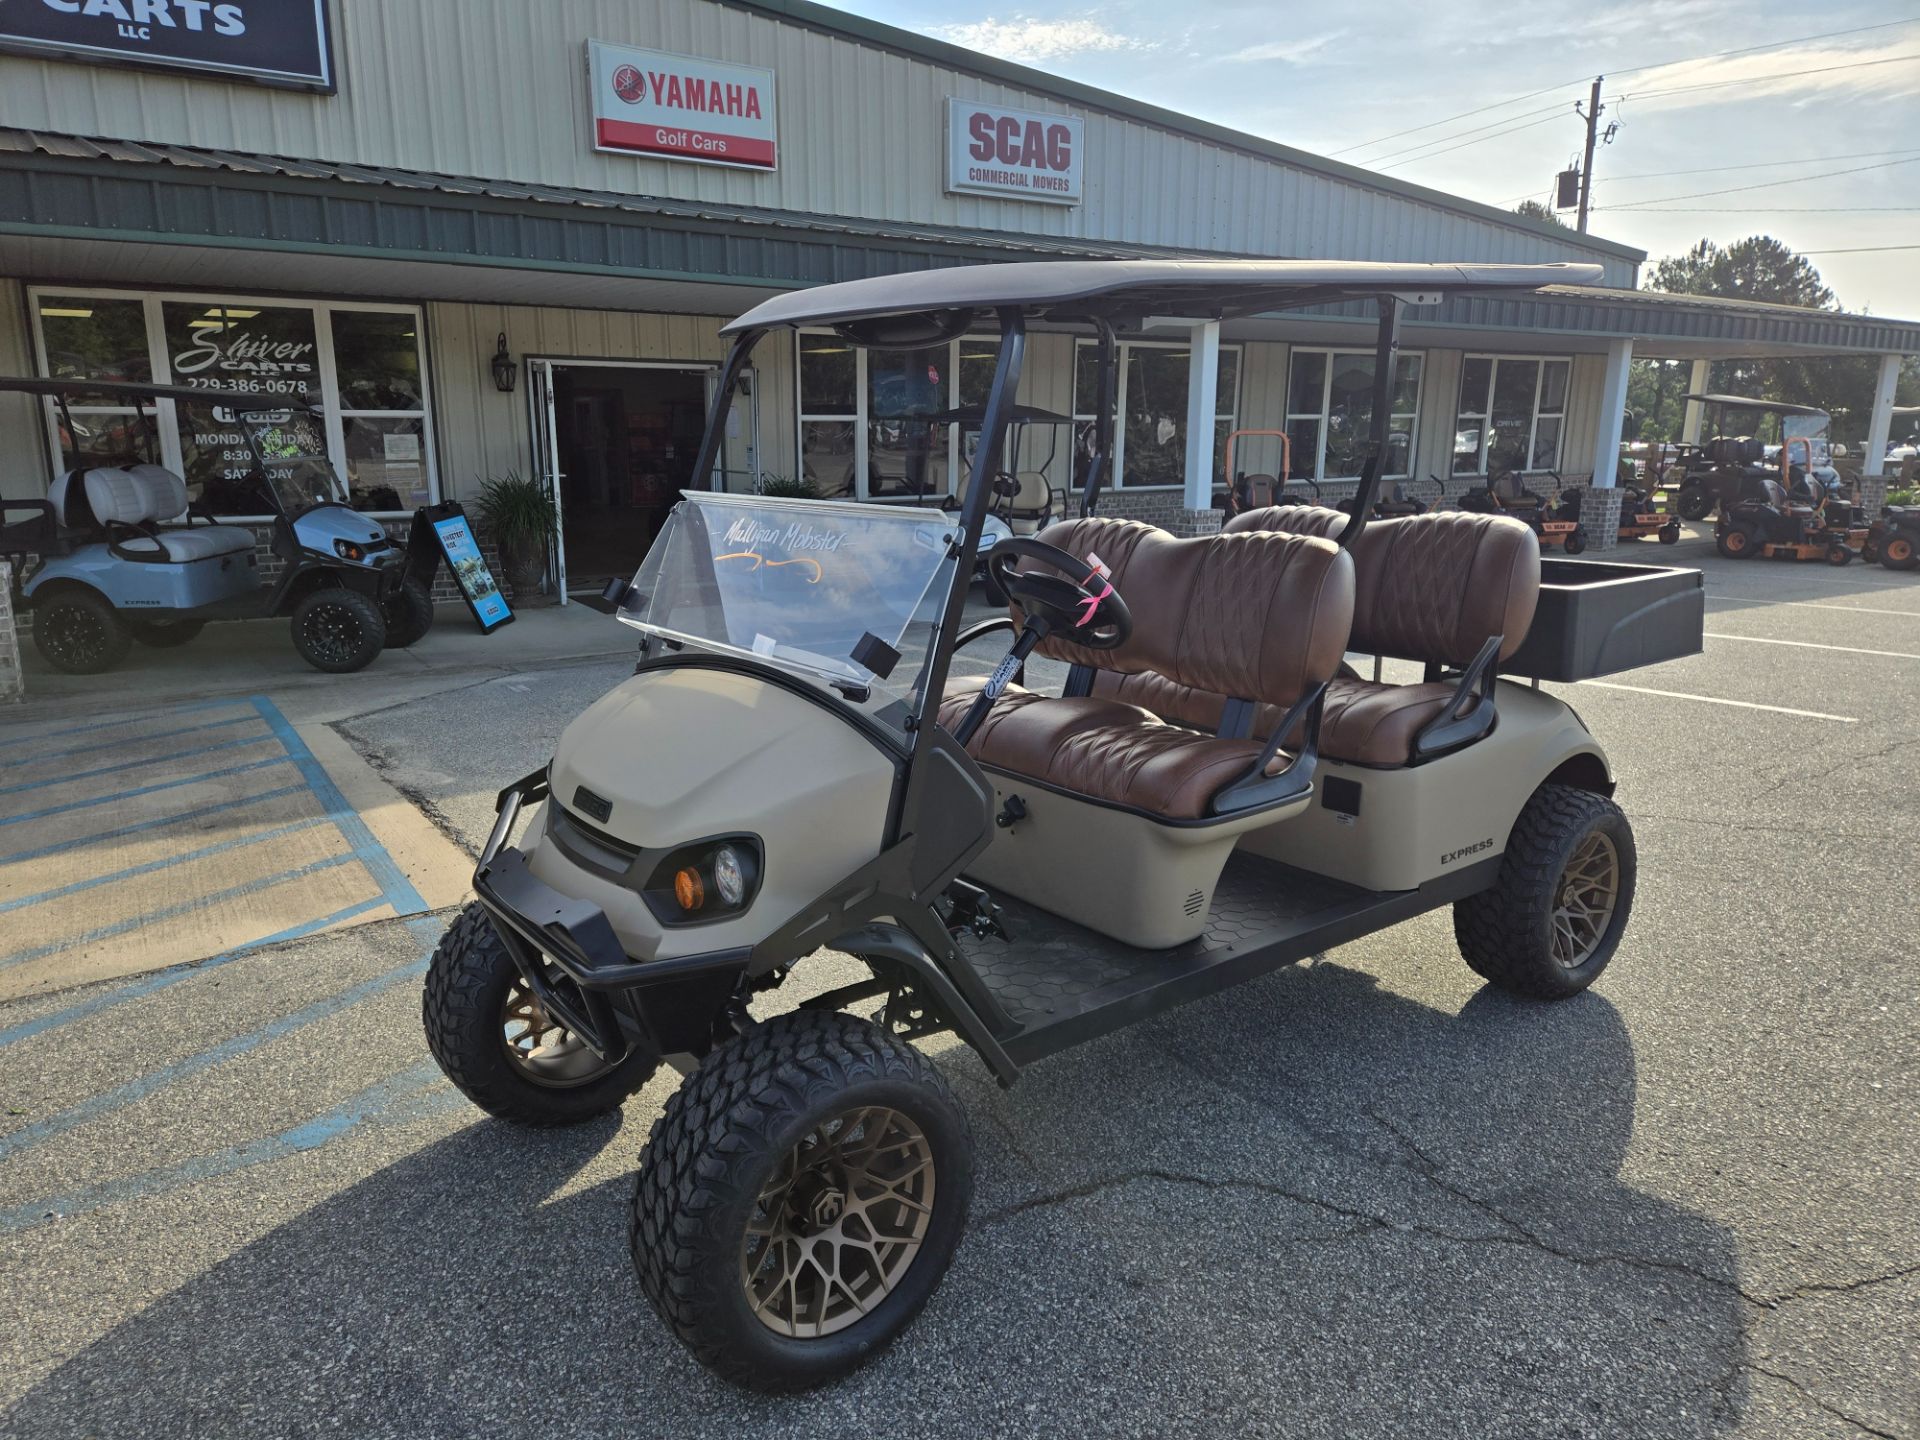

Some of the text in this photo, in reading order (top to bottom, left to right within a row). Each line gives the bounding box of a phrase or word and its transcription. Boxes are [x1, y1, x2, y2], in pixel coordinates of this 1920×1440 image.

[117, 24, 151, 41] LLC
[648, 71, 762, 120] YAMAHA
[656, 129, 727, 153] Golf Cars
[969, 112, 1071, 172] SCAG
[969, 167, 1070, 192] COMMERCIAL MOWERS
[174, 326, 313, 373] Shiver
[220, 361, 312, 373] CARTS
[187, 378, 308, 394] 229-386-0678
[195, 434, 247, 445] MONDA
[223, 450, 252, 461] 8:30
[223, 468, 294, 480] SATDAY
[779, 522, 848, 551] Mobster
[1440, 838, 1494, 865] EXPRESS
